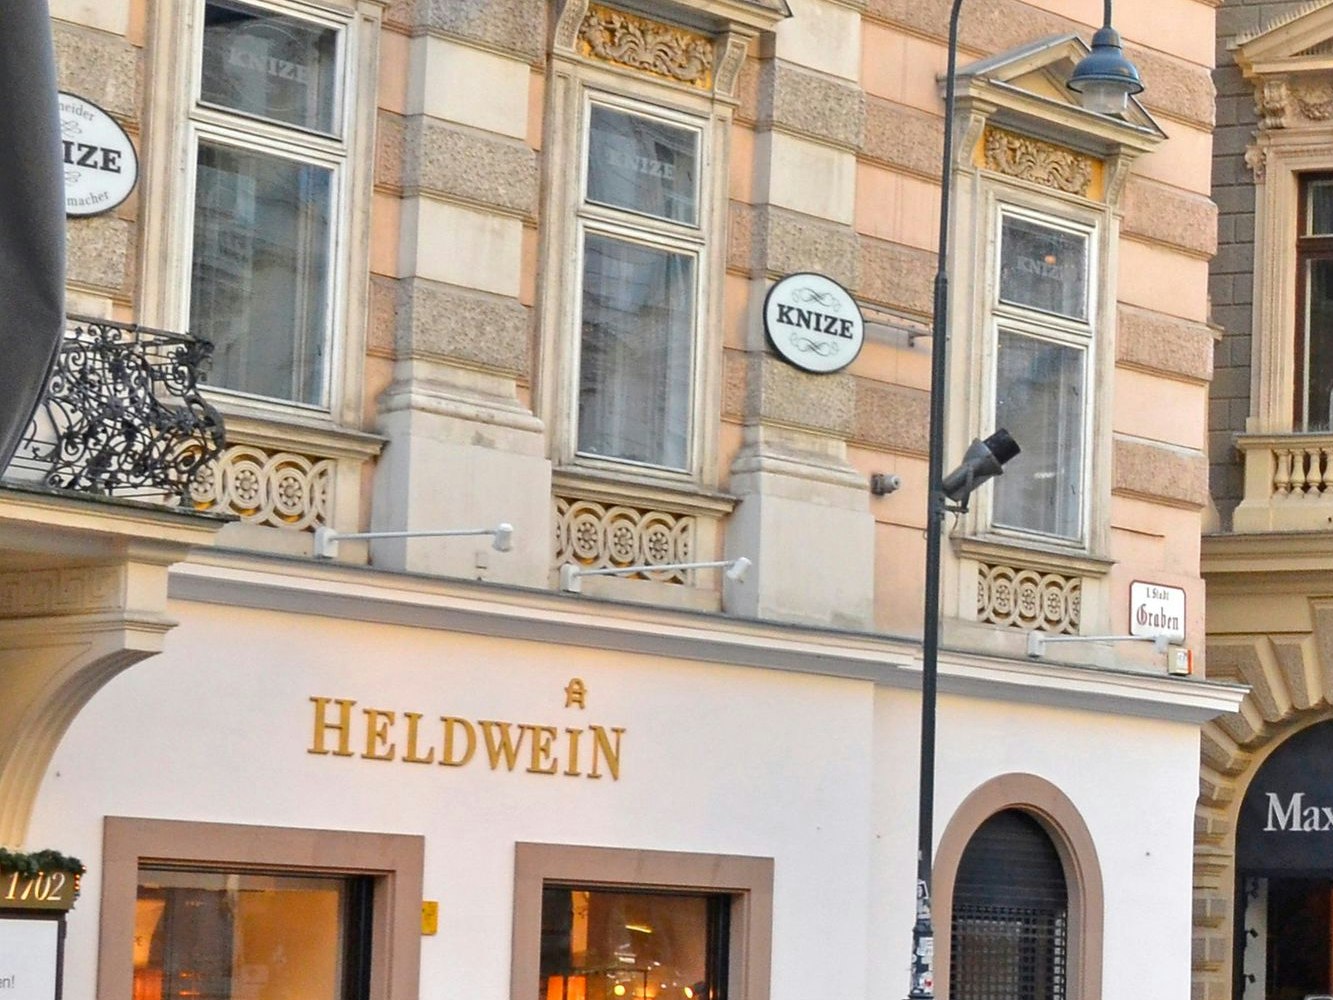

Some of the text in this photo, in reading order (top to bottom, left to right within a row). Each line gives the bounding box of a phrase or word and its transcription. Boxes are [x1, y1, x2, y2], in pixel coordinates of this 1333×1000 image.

[59, 102, 95, 122] neider
[62, 140, 121, 174] IZE
[66, 191, 110, 206] macher
[776, 303, 854, 339] KNIZE
[1136, 603, 1179, 631] Graben
[307, 695, 626, 782] HELDWEIN
